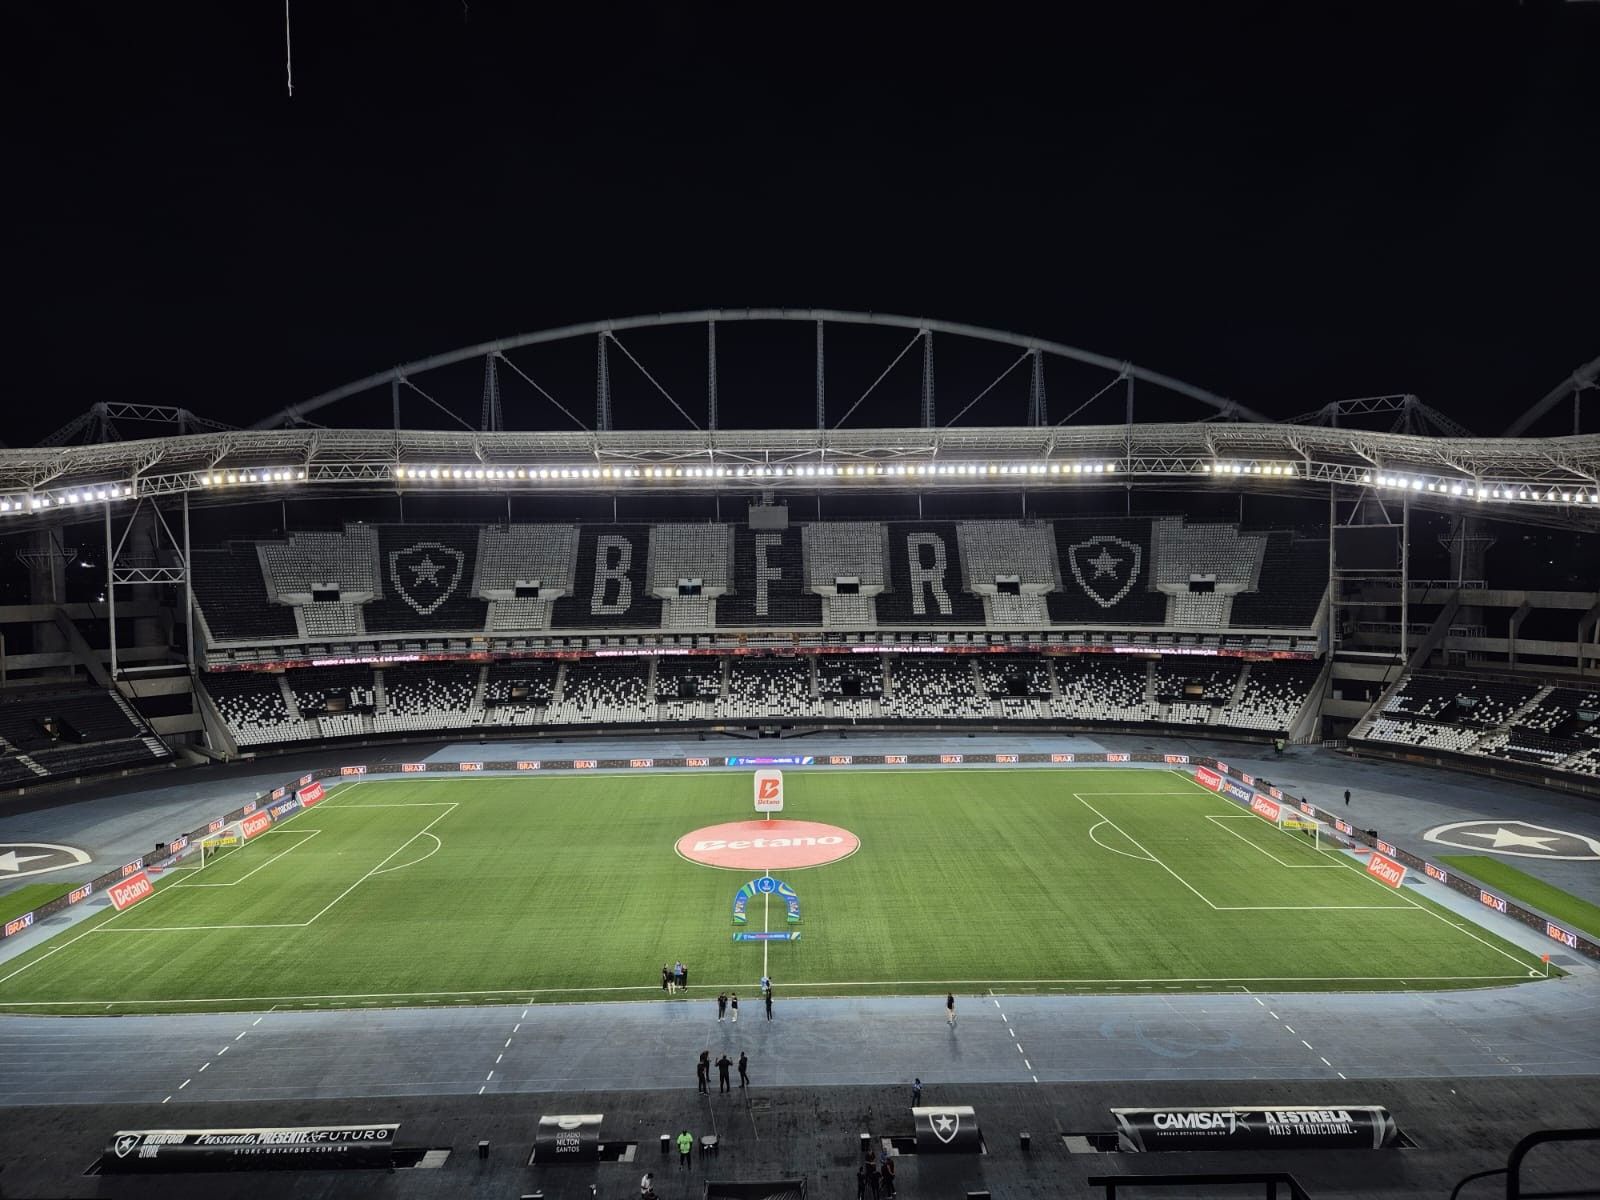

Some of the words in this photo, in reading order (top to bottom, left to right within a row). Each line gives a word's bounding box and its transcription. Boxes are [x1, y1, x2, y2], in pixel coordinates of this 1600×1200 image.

[590, 534, 633, 616] B
[755, 533, 783, 616] F
[907, 532, 953, 615] R
[1254, 799, 1278, 819] Betano
[243, 816, 268, 836] Betano
[172, 838, 187, 853] BRAX
[692, 836, 844, 852] Betano
[1379, 841, 1395, 856] BRAX
[124, 860, 142, 875] BRAX
[1370, 857, 1400, 883] Betano
[1427, 866, 1445, 882] BRAX
[71, 886, 91, 903] BRAX
[114, 879, 149, 905] Betano
[1482, 893, 1504, 911] BRAX
[7, 914, 32, 935] BRAX
[1549, 926, 1574, 947] BRAX
[1264, 1111, 1277, 1123] A
[1275, 1110, 1353, 1123] ESTRELA
[1268, 1124, 1291, 1135] MAIS
[1294, 1123, 1358, 1135] TRADICIONAL.
[142, 1134, 188, 1144] BOTAFOGO
[193, 1132, 256, 1146] Passado,
[318, 1129, 388, 1141] FUTURO
[556, 1138, 580, 1146] NILTON
[138, 1144, 160, 1158] STORE
